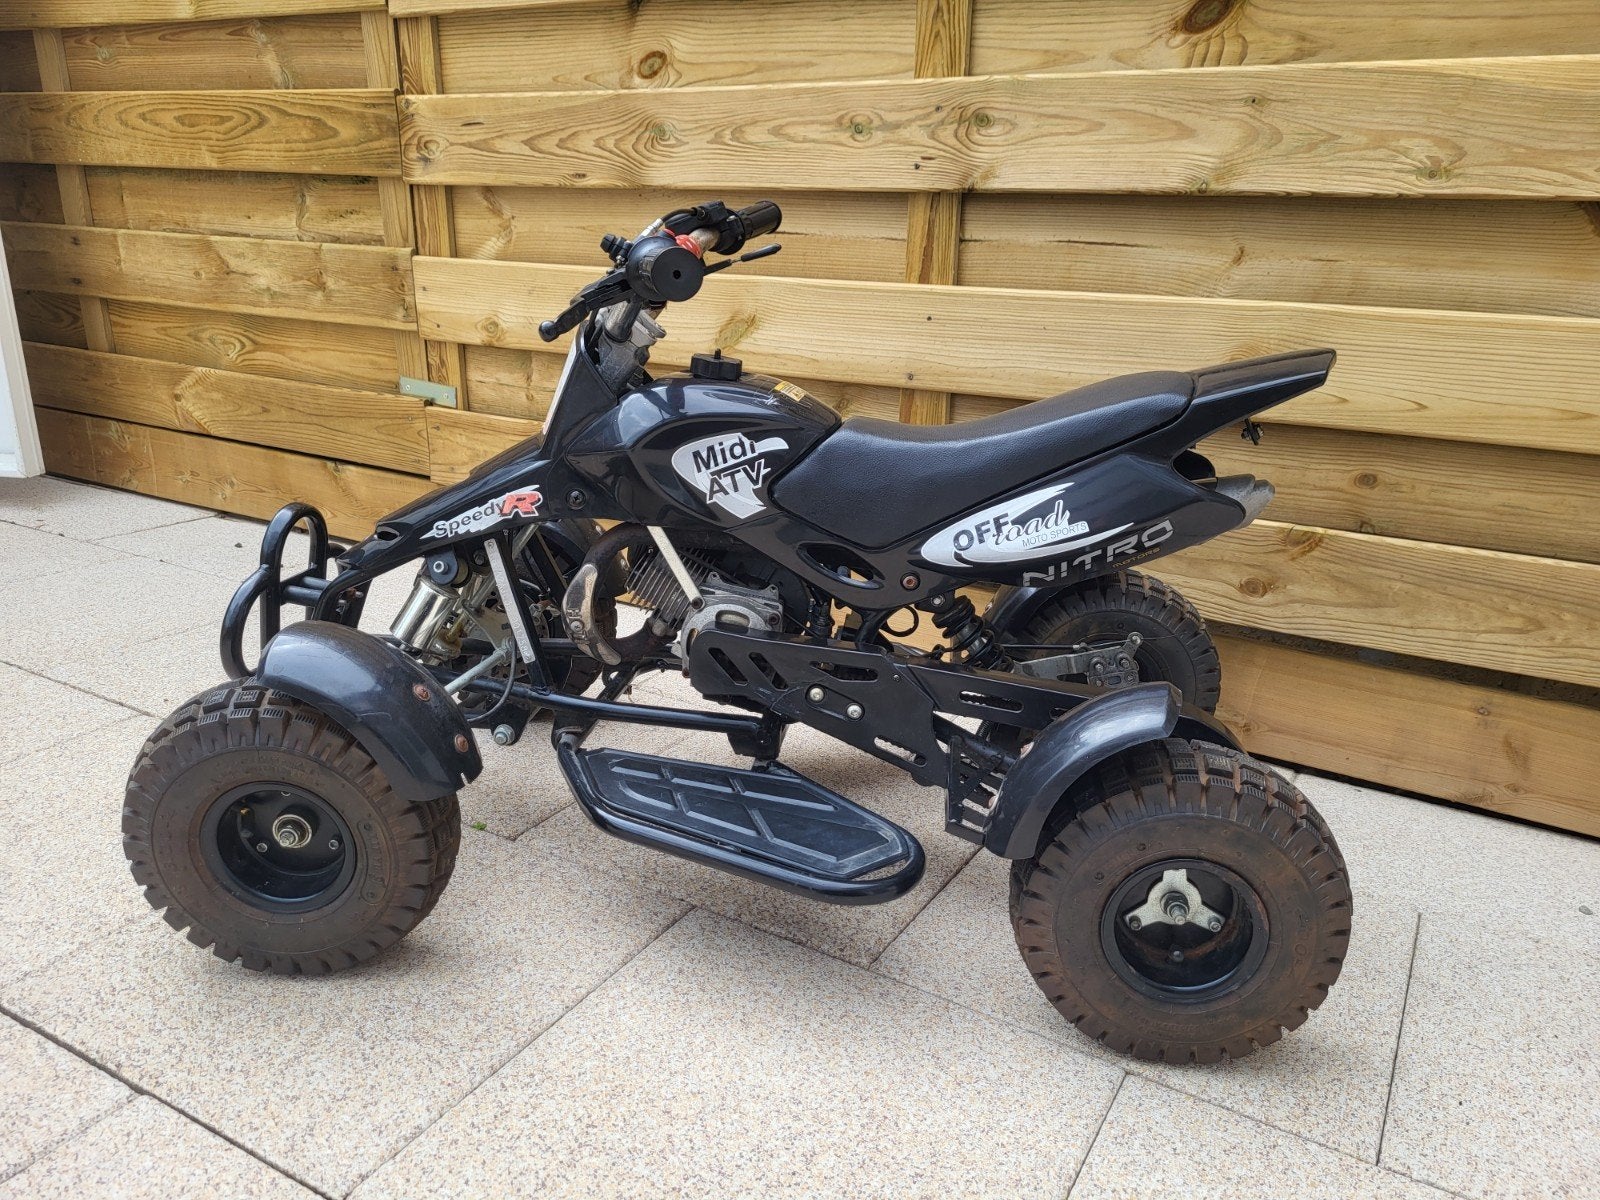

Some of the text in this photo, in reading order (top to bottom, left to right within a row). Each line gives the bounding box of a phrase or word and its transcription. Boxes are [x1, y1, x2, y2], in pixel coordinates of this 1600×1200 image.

[691, 435, 757, 474] Midi
[708, 459, 765, 502] ATV
[953, 512, 1010, 551] OFF
[1021, 521, 1087, 548] MOTO SPORTS
[1022, 519, 1175, 587] NITRO
